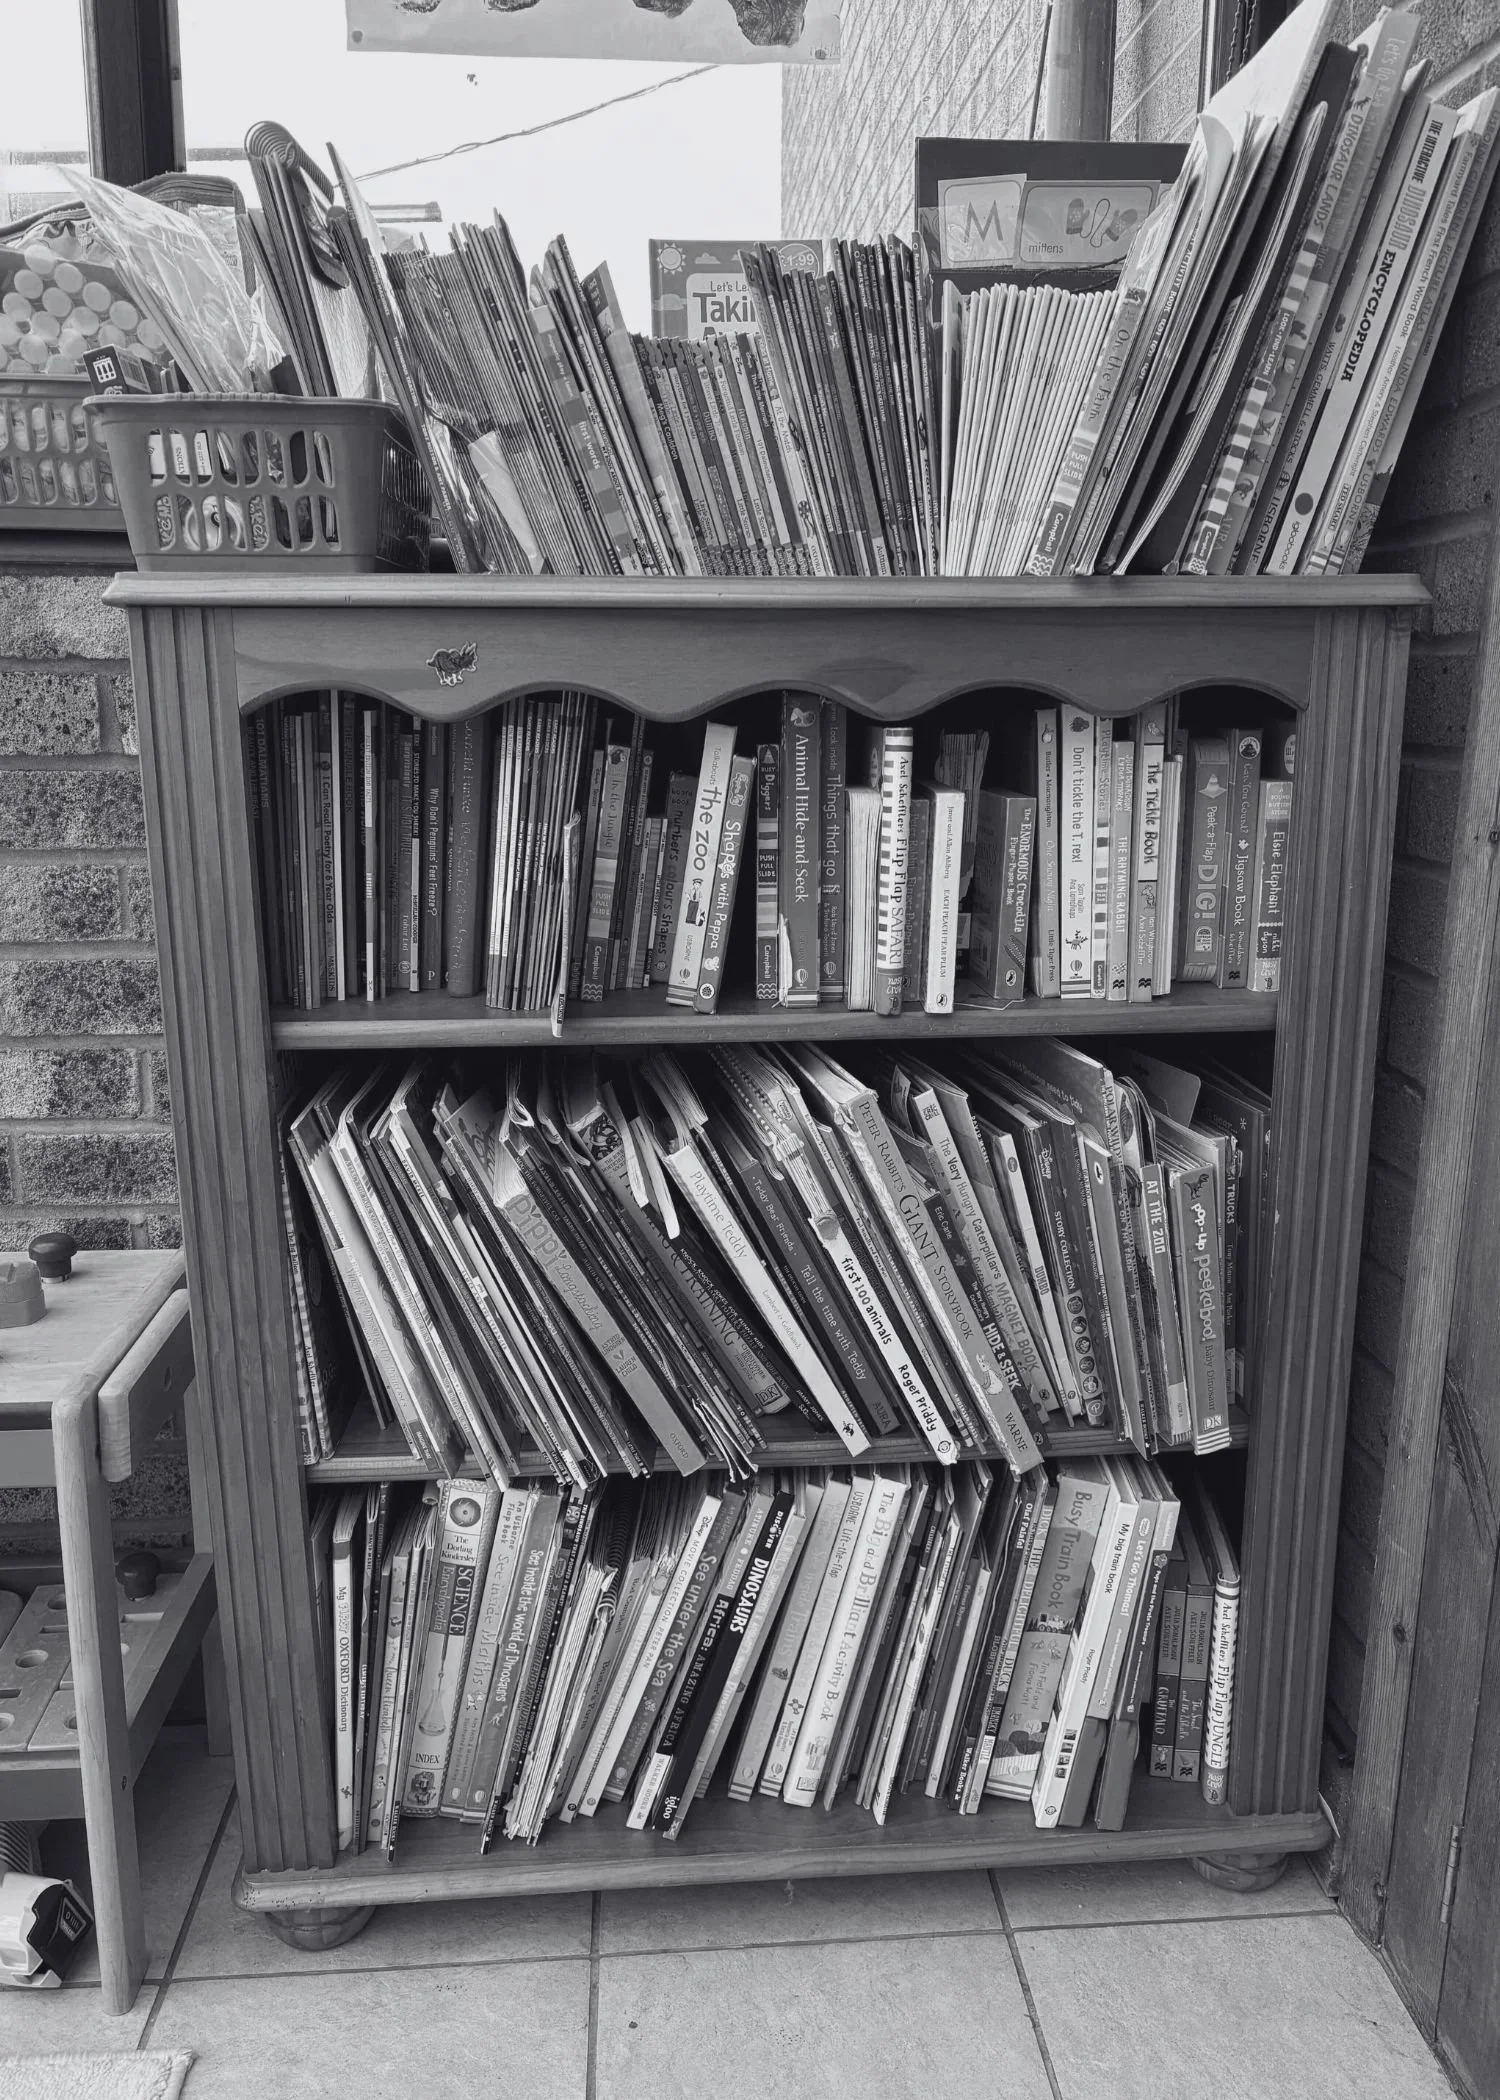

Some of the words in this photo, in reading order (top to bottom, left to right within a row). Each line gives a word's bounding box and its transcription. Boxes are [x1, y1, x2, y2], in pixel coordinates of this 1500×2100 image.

[1427, 119, 1443, 136] THE
[1328, 112, 1364, 182] DINOSAUR
[1410, 134, 1437, 183] INTERACTIVE
[1448, 150, 1473, 198] Farmyard
[965, 200, 1003, 243] M
[1311, 183, 1339, 229] LANDS
[1387, 184, 1427, 251] DINOSAUR
[1440, 199, 1456, 224] Tales
[1029, 243, 1064, 254] mittens
[1431, 225, 1446, 248] First
[1419, 248, 1438, 283] French
[1340, 248, 1397, 381] ENCYCLOPEDIA
[1409, 284, 1425, 311] Word
[1399, 312, 1415, 338] Book
[1392, 355, 1414, 394] LINDA
[654, 402, 668, 425] Meg's
[662, 426, 679, 460] Cauldron
[1370, 396, 1399, 453] EDWARDS
[577, 420, 592, 440] first
[585, 440, 602, 470] words
[1044, 511, 1064, 552] Campbell
[795, 734, 808, 790] Animal
[1072, 747, 1085, 774] Don't
[1146, 763, 1160, 784] The
[428, 788, 438, 804] Why
[760, 773, 775, 810] Diggers
[1072, 778, 1084, 808] tickle
[1143, 788, 1159, 825] Tickle
[429, 806, 438, 825] Don't
[1072, 811, 1084, 829] the
[322, 830, 331, 856] Poetry
[428, 827, 438, 862] Penguins'
[716, 819, 742, 879] Shapes
[795, 795, 808, 902] Hide-and-Seek
[1072, 832, 1084, 840] T.
[1117, 835, 1128, 853] THE
[1142, 831, 1157, 865] Book
[1203, 805, 1219, 861] Peek-a-Flap
[1271, 831, 1285, 859] Elsie
[1071, 843, 1084, 862] rex!
[429, 865, 437, 881] Feet
[1115, 856, 1128, 898] RHYMING
[1262, 863, 1284, 915] Elephant
[428, 883, 437, 916] Freeze?
[716, 881, 730, 909] with
[1194, 863, 1219, 919] DIG!
[705, 912, 725, 949] Peppa
[1114, 902, 1126, 933] RABBIT
[763, 944, 771, 978] Campbell
[937, 1137, 955, 1157] The
[942, 1155, 964, 1182] Very
[951, 1181, 979, 1219] Hungry
[1143, 1179, 1158, 1197] AT
[1226, 1185, 1235, 1224] TRUCKS
[687, 1169, 729, 1225] Playtime
[718, 1220, 751, 1261] Teddy
[751, 1179, 771, 1204] Teddy
[765, 1202, 781, 1223] Bear
[775, 1221, 797, 1251] Friends
[856, 1100, 884, 1140] PETER
[874, 1140, 910, 1194] RABBIT'S
[895, 1191, 944, 1263] GIANT
[931, 1264, 977, 1340] STORYBOOK
[933, 1205, 946, 1220] Eric
[940, 1219, 955, 1239] Carle
[1051, 1210, 1066, 1238] STORY
[1146, 1200, 1162, 1225] THE
[1191, 1204, 1208, 1249] pop-up
[967, 1217, 1005, 1281] Caterpillar's
[1150, 1227, 1166, 1254] ZOO
[1032, 1265, 1050, 1295] DUMBO
[1057, 1239, 1078, 1289] COLLECTION
[840, 1255, 863, 1284] first
[854, 1282, 874, 1305] 100
[865, 1303, 894, 1345] animals
[992, 1281, 1026, 1338] MAGNET
[1193, 1254, 1219, 1341] peekaboo!
[799, 1263, 818, 1285] Tell
[810, 1284, 828, 1304] the
[820, 1302, 841, 1327] time
[833, 1326, 854, 1352] with
[844, 1350, 870, 1382] Teddy
[981, 1322, 1005, 1353] HIDE
[995, 1351, 1006, 1360] &
[1016, 1338, 1040, 1373] BOOK
[1202, 1345, 1212, 1366] Baby
[997, 1358, 1021, 1391] SEEK
[1205, 1370, 1216, 1410] Dinosaur
[872, 1400, 892, 1427] AURA
[896, 1363, 922, 1397] Roger
[913, 1395, 940, 1432] Priddy
[665, 1431, 692, 1459] OXFORD
[1001, 1411, 1029, 1452] WARNE
[503, 1502, 515, 1521] Flap
[515, 1500, 524, 1512] An
[843, 1489, 866, 1525] USBORNE
[878, 1490, 895, 1515] The
[1022, 1502, 1033, 1520] Olaf
[1062, 1488, 1092, 1528] Busy
[500, 1524, 511, 1544] Book
[508, 1514, 522, 1550] Usborne
[865, 1515, 892, 1548] Big
[1015, 1521, 1029, 1549] Falafel
[1036, 1507, 1053, 1536] DICK
[1118, 1522, 1130, 1536] My
[682, 1539, 699, 1567] MOVIE
[825, 1527, 855, 1579] Lift-the-flap
[862, 1547, 878, 1570] and
[1028, 1544, 1043, 1568] THE
[1056, 1528, 1081, 1572] Train
[1114, 1537, 1126, 1551] big
[692, 1551, 718, 1583] See
[1110, 1552, 1122, 1571] train
[431, 1565, 454, 1631] Encyclopedia
[659, 1569, 688, 1622] COLLECTION
[728, 1556, 769, 1635] DINOSAURS
[1046, 1572, 1070, 1610] Book
[1104, 1572, 1116, 1594] book
[448, 1566, 473, 1635] SCIENCE
[674, 1582, 704, 1630] under
[842, 1570, 877, 1640] Brilliant
[1008, 1580, 1034, 1648] DELIGHTFUL
[648, 1626, 664, 1651] PETER
[699, 1598, 729, 1653] Africa:
[641, 1651, 654, 1668] PAN
[663, 1629, 685, 1659] the
[1085, 1648, 1095, 1665] Roger
[650, 1658, 674, 1689] Sea
[679, 1653, 705, 1704] AMAZING
[827, 1639, 853, 1688] Activity
[997, 1656, 1015, 1688] DUCK
[1080, 1665, 1090, 1684] Priddy
[819, 1689, 839, 1723] Book
[1153, 1685, 1171, 1734] GRUFFALO
[662, 1706, 684, 1748] AFRICA
[416, 1753, 440, 1764] INDEX
[648, 1757, 664, 1787] WALKER
[639, 1788, 652, 1810] BOOKS
[661, 1794, 679, 1820] igloo
